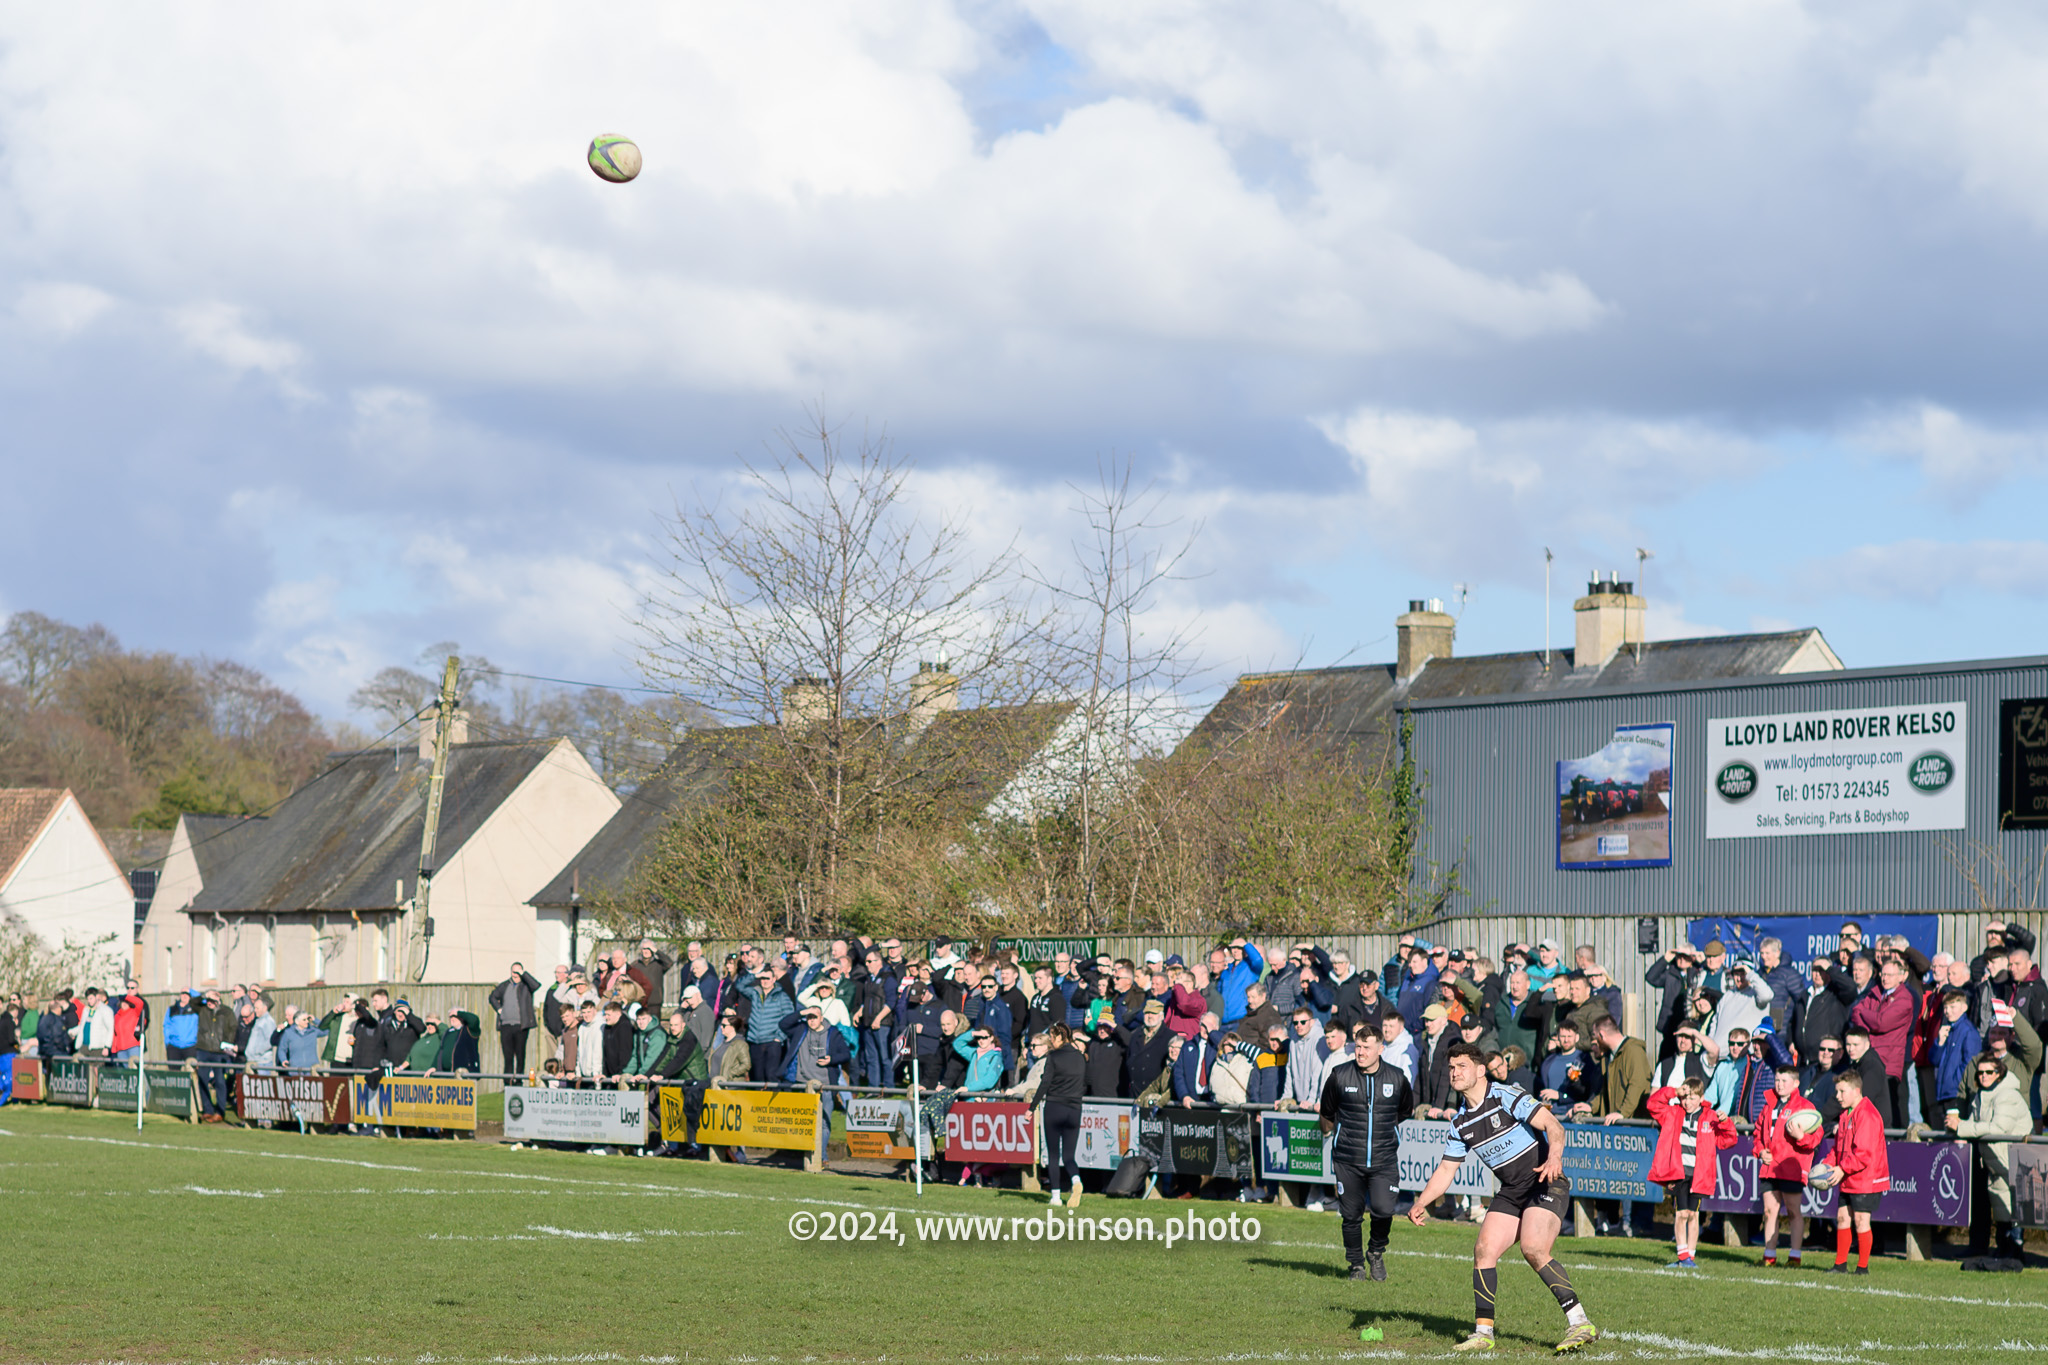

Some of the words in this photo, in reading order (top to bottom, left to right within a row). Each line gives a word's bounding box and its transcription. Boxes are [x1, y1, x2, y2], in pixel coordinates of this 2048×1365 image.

[1725, 723, 1777, 746] LLOYD
[1783, 719, 1828, 742] LAND
[1832, 715, 1890, 740] ROVER
[1896, 711, 1955, 736] KELSO
[1611, 735, 1634, 744] cultural
[1635, 735, 1666, 749] Contractor
[1764, 750, 1903, 772] www.lloydmotorgroup.com
[1917, 758, 1940, 773] LAND
[1723, 767, 1746, 781] LAND
[1918, 771, 1947, 786] ROVER
[1725, 780, 1752, 794] ROVER
[1776, 785, 1798, 802] Tel:
[1802, 782, 1839, 801] 01573
[1844, 780, 1890, 799] 224345
[1756, 814, 1782, 828] Sales,
[1784, 812, 1827, 829] Servicing,
[1829, 810, 1852, 824] Parts
[1855, 810, 1861, 824] &
[1864, 808, 1910, 825] Bodyshop
[1016, 939, 1093, 962] CONSERVATION
[1808, 934, 1840, 956] PROU
[242, 1074, 275, 1098] Grant
[357, 1083, 392, 1116] MM
[394, 1084, 432, 1104] BUILDING
[435, 1086, 474, 1106] SUPPLIES
[528, 1091, 549, 1104] LLOYD
[551, 1092, 568, 1105] LAND
[571, 1093, 592, 1106] ROVER
[595, 1093, 617, 1107] KELSO
[620, 1107, 640, 1127] Lloyd
[701, 1102, 718, 1131] OT
[720, 1103, 742, 1132] JCB
[1141, 1119, 1164, 1135] BELHAVEN
[945, 1113, 1032, 1153] PLEXUS
[1290, 1126, 1322, 1141] BORDER
[1406, 1127, 1427, 1143] SALE
[1604, 1134, 1612, 1150] &
[1481, 1139, 1514, 1159] ALCOLM
[1290, 1159, 1322, 1172] EXCHANGE
[1561, 1153, 1592, 1170] movals
[1594, 1155, 1602, 1170] &
[1604, 1155, 1639, 1178] Storage
[1930, 1147, 1949, 1180] PROPERTY
[1577, 1177, 1607, 1194] 01573
[1609, 1180, 1646, 1197] 225735
[1939, 1164, 1959, 1200] &
